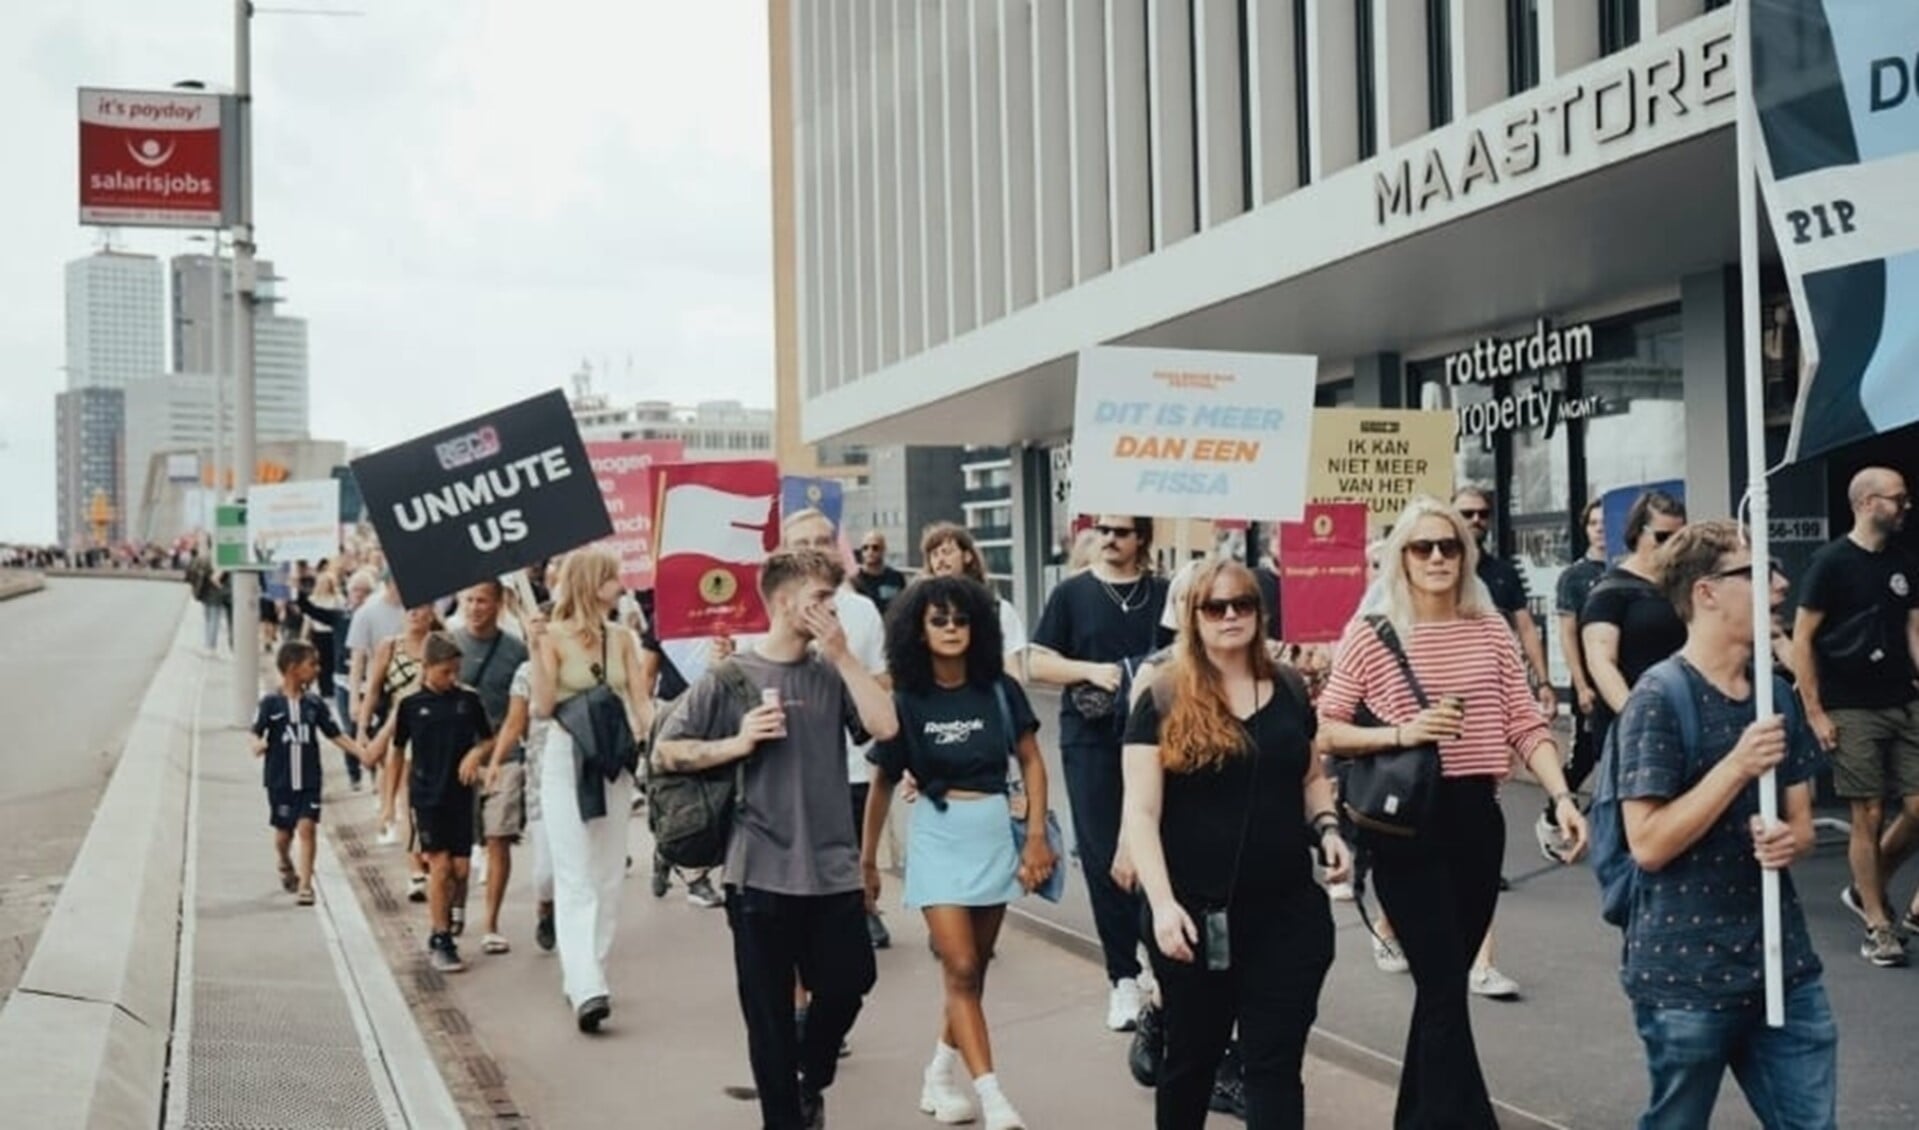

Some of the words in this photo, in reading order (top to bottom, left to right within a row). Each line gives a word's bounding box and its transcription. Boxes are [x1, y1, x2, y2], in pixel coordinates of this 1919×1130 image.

[1869, 54, 1919, 112] D
[98, 97, 125, 115] it's
[129, 100, 202, 121] payday!
[90, 171, 212, 196] salarisjobs
[1445, 318, 1594, 387] rotterdam
[1095, 401, 1149, 425] DIT
[1155, 403, 1186, 427] IS
[1192, 406, 1286, 432] MEER
[1455, 386, 1553, 449] roperty
[1114, 436, 1187, 460] DAN
[1192, 439, 1260, 463] EEN
[1348, 439, 1367, 454] IK
[1372, 441, 1409, 454] KAN
[1328, 459, 1370, 474] NIET
[1375, 461, 1428, 475] MEER
[393, 446, 572, 531] UNMUTE
[1135, 469, 1230, 495] FISSA
[1339, 478, 1373, 493] VAN
[1378, 479, 1415, 493] HET
[468, 509, 528, 552] US
[924, 719, 984, 734] Reebok
